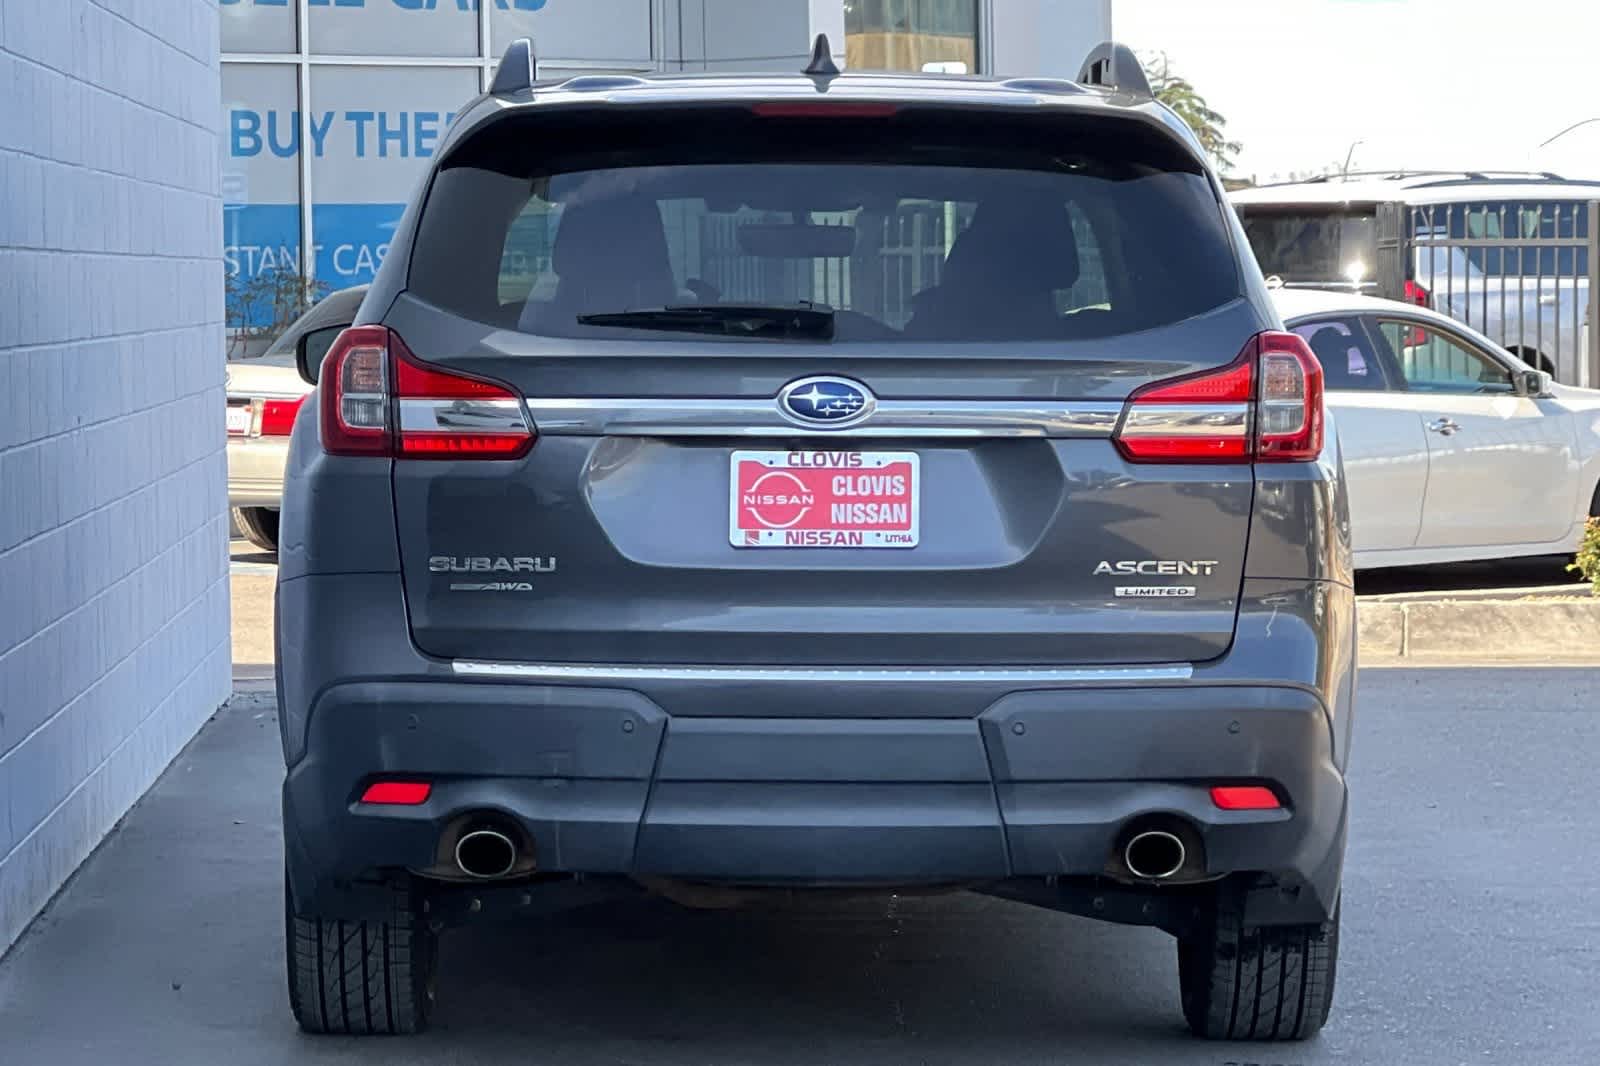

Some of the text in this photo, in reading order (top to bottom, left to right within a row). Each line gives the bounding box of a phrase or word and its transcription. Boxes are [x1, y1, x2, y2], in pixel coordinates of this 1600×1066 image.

[230, 110, 455, 158] BUY THE
[787, 452, 863, 467] CLOVIS
[832, 475, 905, 496] CLOVIS
[743, 495, 814, 505] NISSAN
[831, 503, 907, 524] NISSAN
[785, 531, 863, 545] NISSAN
[429, 557, 556, 572] SUBARU
[1092, 560, 1219, 575] ASCENT
[481, 582, 533, 591] AWD
[1124, 588, 1188, 596] LIMITED
